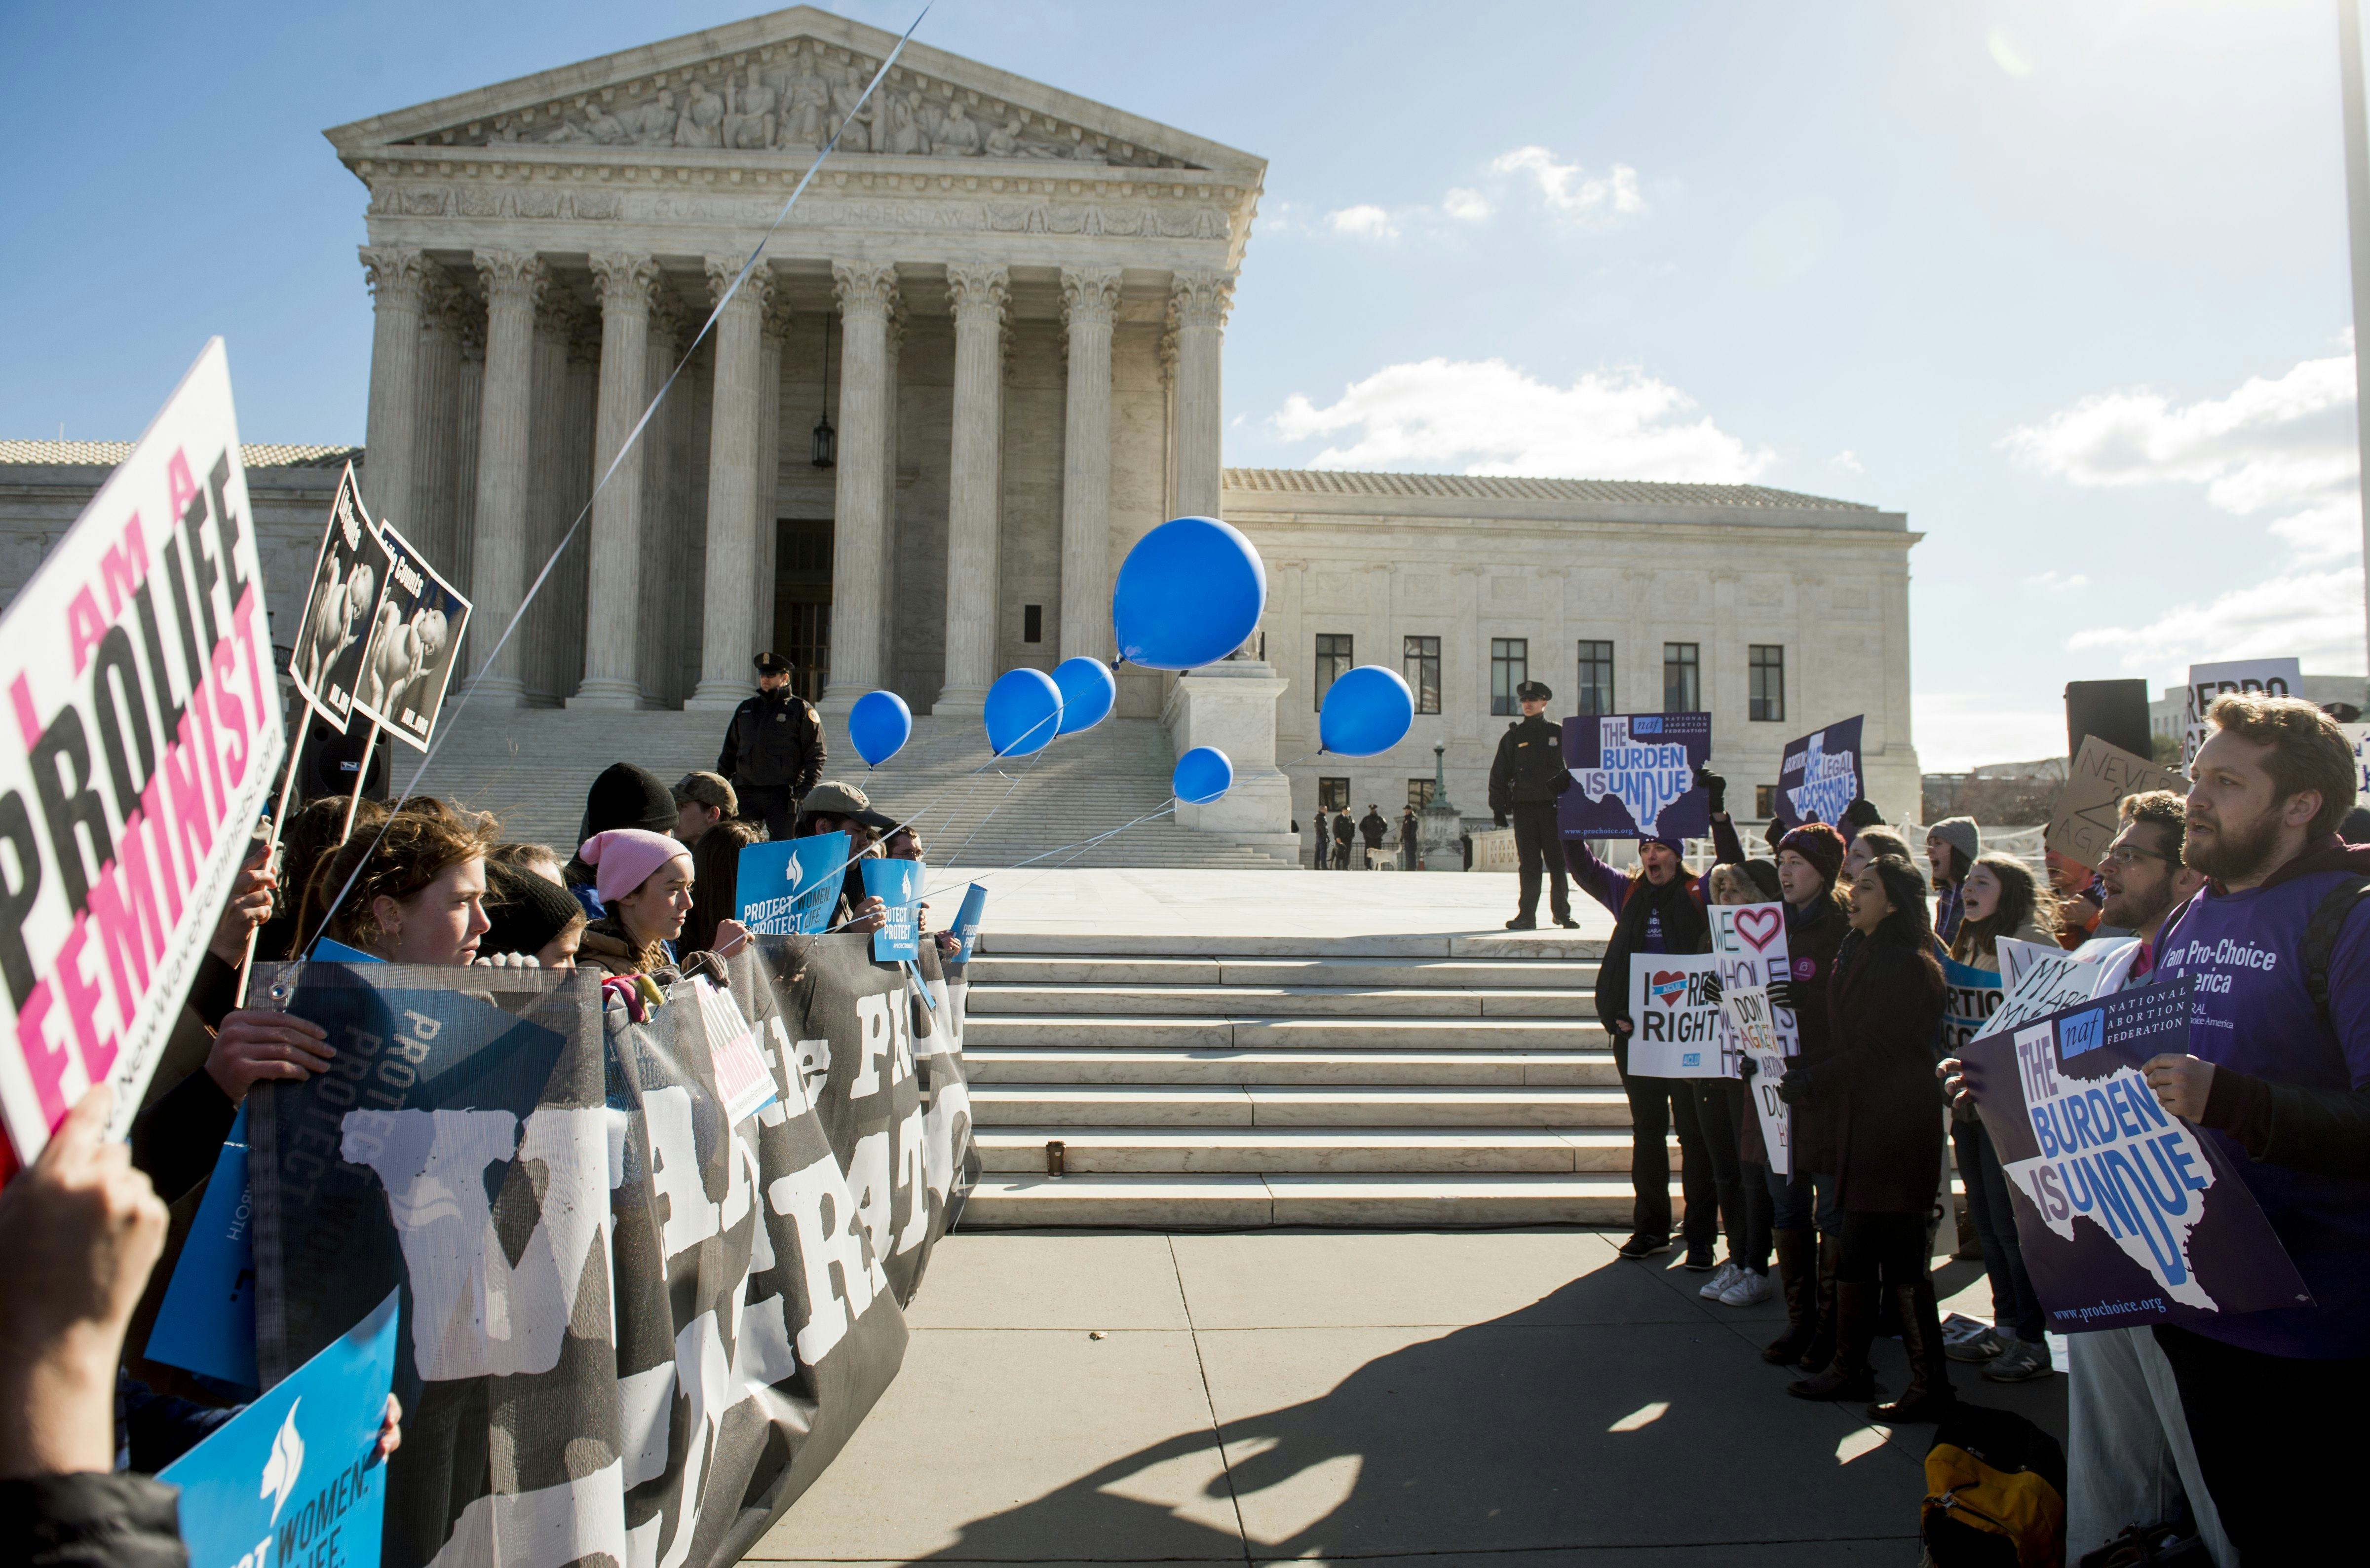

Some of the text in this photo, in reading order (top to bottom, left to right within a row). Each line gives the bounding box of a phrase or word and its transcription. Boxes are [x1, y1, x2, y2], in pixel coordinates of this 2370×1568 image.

[640, 197, 719, 218] EQUAL
[831, 203, 911, 223] UNDER
[918, 206, 963, 226] LAW
[395, 556, 423, 598] Counts
[11, 445, 197, 752] I AM A
[0, 446, 248, 1015] PROLIFE
[401, 707, 429, 736] AUL.ORG
[1602, 723, 1626, 747] THE
[1638, 717, 1660, 734] naf
[1603, 747, 1683, 771] BURDEN
[1823, 753, 1853, 779] LEGAL
[1586, 770, 1686, 826] IS UNDUE
[1797, 773, 1854, 829] ACCESSIBLE
[1565, 827, 1633, 836] www.prochoice.org
[17, 582, 267, 1133] FEMINIST
[744, 886, 831, 923] PROTECT WOMEN.
[884, 907, 907, 923] ROTECT
[753, 913, 803, 934] PROTECT
[884, 924, 911, 940] PROTECT
[1711, 911, 1740, 951] WE
[2165, 947, 2183, 969] am
[2186, 938, 2277, 971] Pro-Choice
[1643, 971, 1650, 1006] I
[1662, 981, 1682, 993] ACLU
[2108, 986, 2187, 1014] NATIONAL
[2107, 1002, 2185, 1030] ABORTION
[2191, 1002, 2207, 1014] RAL
[2205, 1017, 2234, 1029] America
[2065, 1007, 2103, 1052] naf
[2107, 1017, 2183, 1045] FEDERATION
[1683, 1054, 1701, 1066] ACLU
[2019, 1036, 2058, 1103] THE
[336, 1009, 443, 1186] PROTECT
[285, 1024, 383, 1207] PROTECT
[2031, 1074, 2169, 1159] BURDEN
[2029, 1131, 2209, 1287] IS UNDUE
[2053, 1294, 2167, 1323] www.prochoice.org
[278, 1453, 369, 1568] WOMEN.
